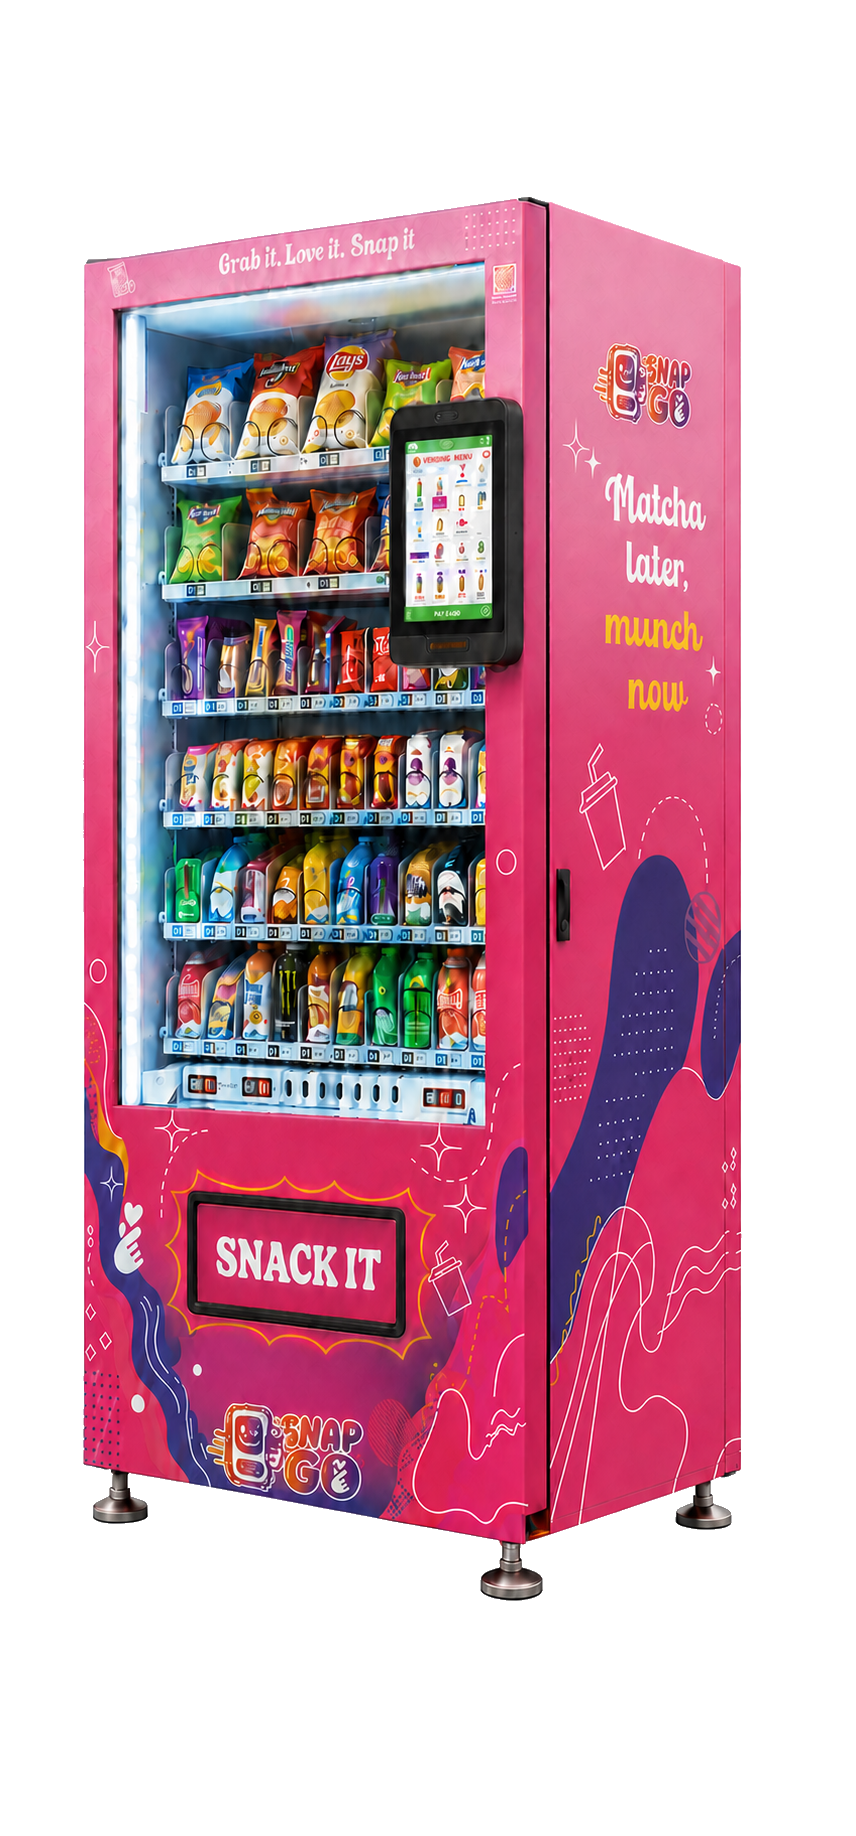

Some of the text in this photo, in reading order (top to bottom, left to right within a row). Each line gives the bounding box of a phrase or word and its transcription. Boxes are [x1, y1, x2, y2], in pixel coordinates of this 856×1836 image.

[219, 227, 415, 275] Grab it. Love it. Snap it
[645, 353, 692, 389] SNAP
[605, 473, 706, 531] Matcha
[626, 541, 688, 592] later,
[605, 611, 703, 651] munch
[628, 679, 688, 712] now
[216, 1236, 382, 1291] SNACK IT
[280, 1413, 364, 1454] SNAP
[284, 1449, 362, 1501] GO
